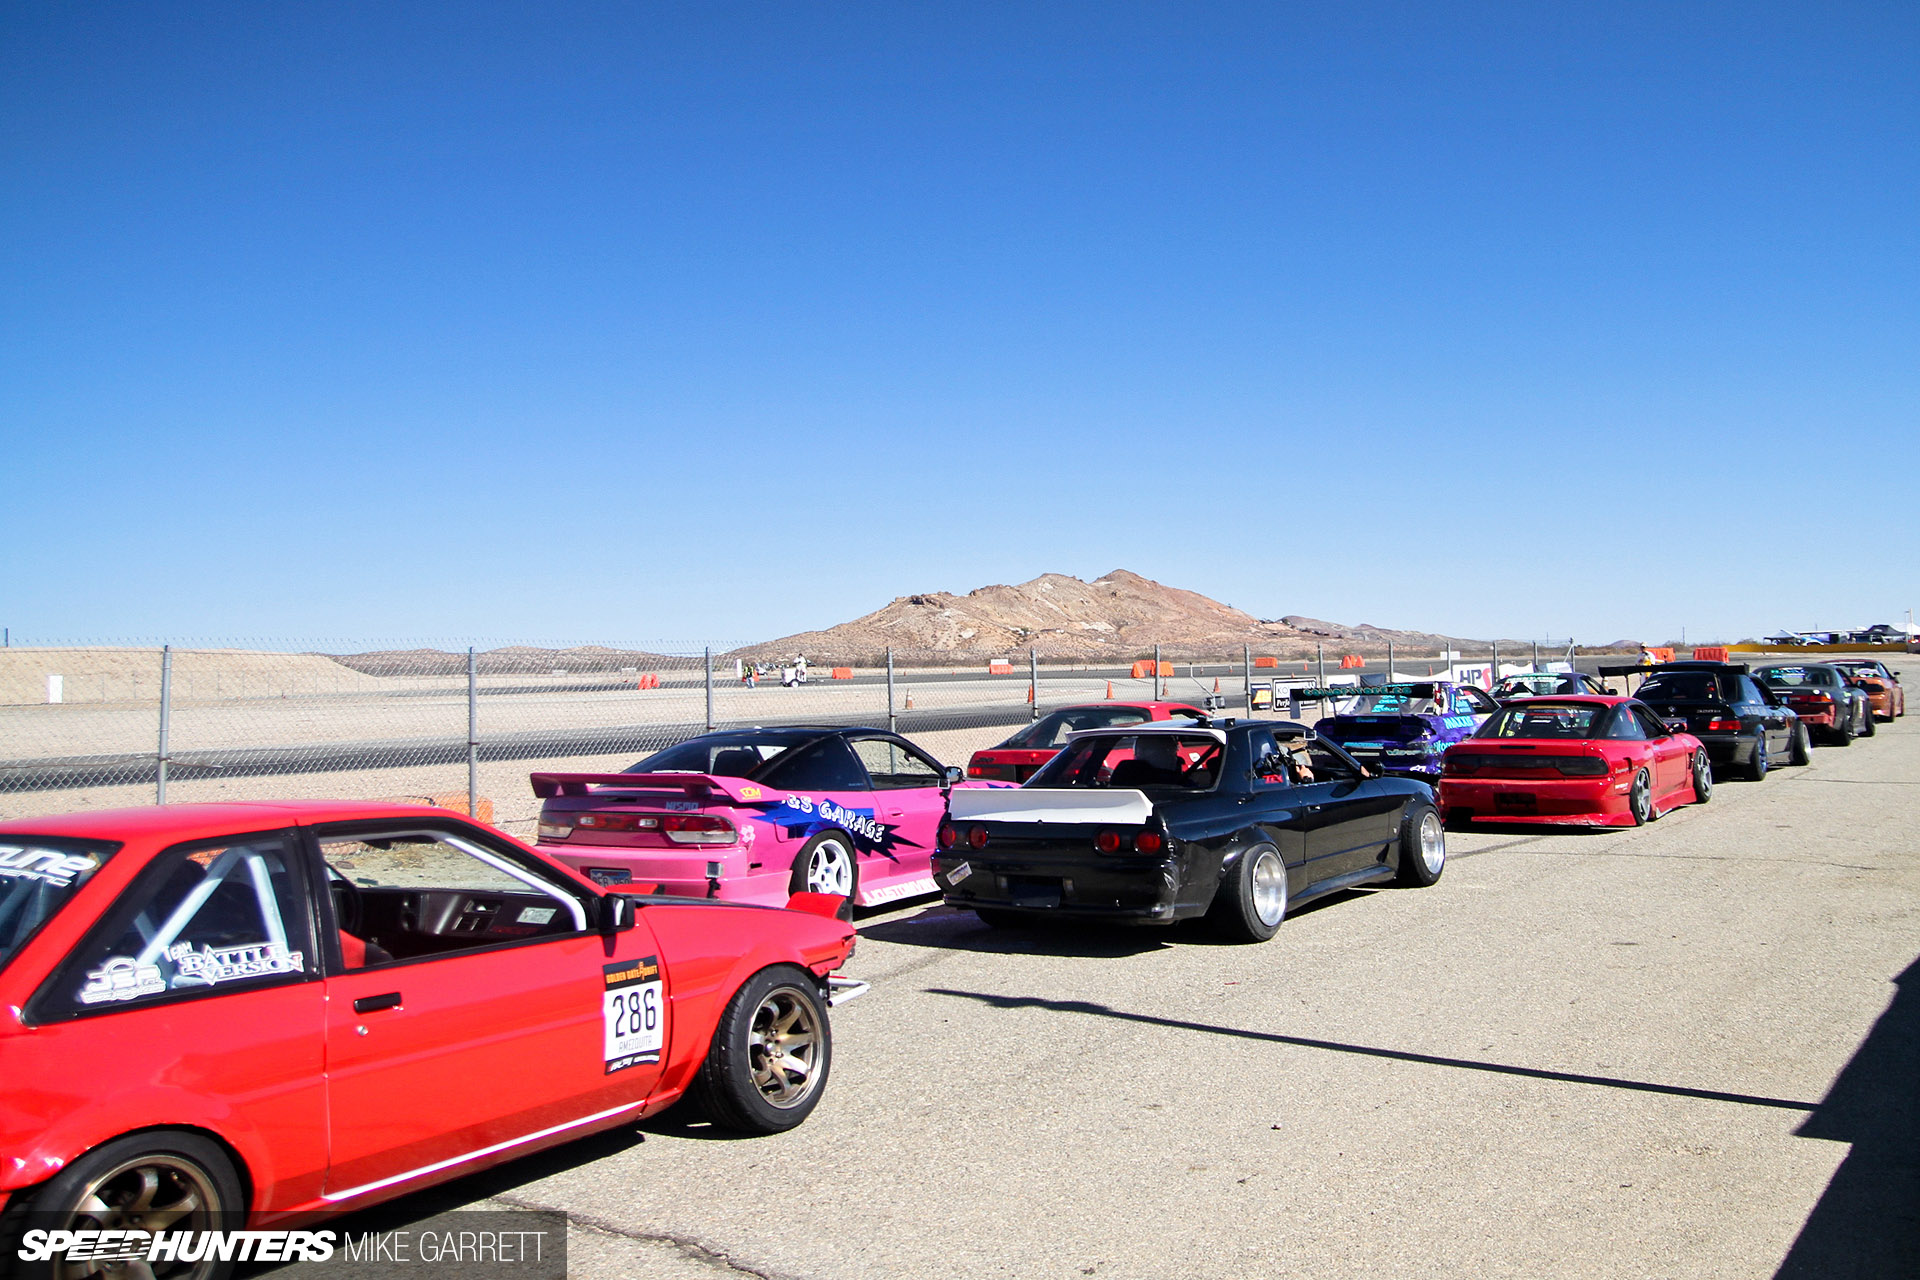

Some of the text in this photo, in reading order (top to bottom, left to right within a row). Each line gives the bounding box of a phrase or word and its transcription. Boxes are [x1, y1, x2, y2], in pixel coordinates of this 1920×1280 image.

[665, 801, 699, 811] NISMO
[818, 801, 885, 843] GARAGE
[163, 940, 193, 963] TEAM
[182, 944, 289, 975] BATTLE
[202, 953, 305, 985] VERSION
[612, 988, 656, 1038] 286
